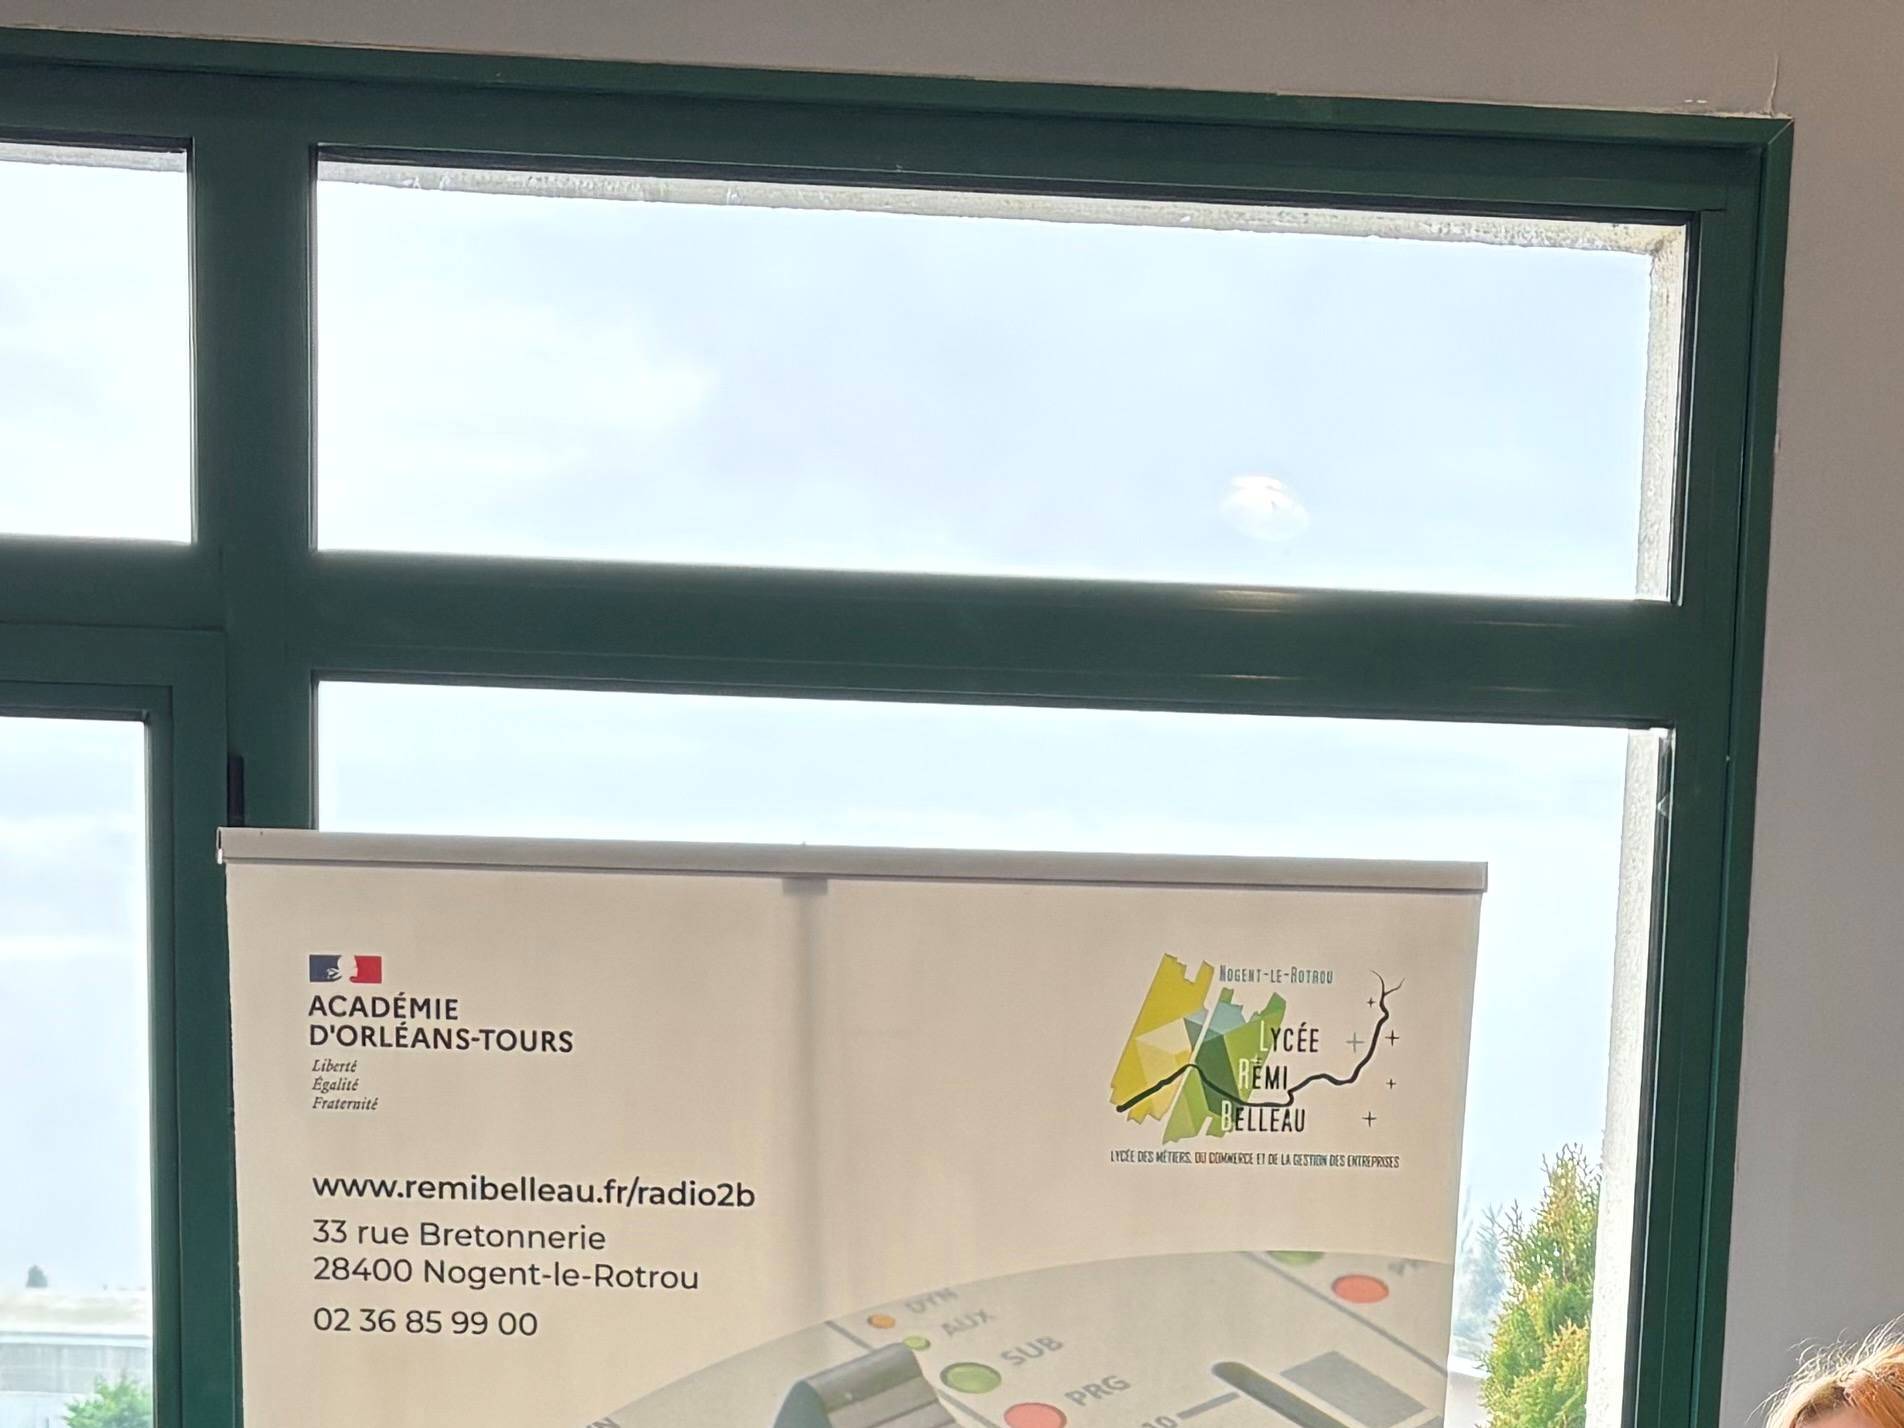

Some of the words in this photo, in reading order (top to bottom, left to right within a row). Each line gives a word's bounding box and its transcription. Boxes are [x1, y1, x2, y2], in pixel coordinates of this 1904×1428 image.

[308, 991, 459, 1021] ACADÉMIE
[310, 1021, 573, 1053] D'ORLÉANS-TOURS
[1259, 1020, 1320, 1053] LYCÉE
[311, 1058, 358, 1074] Liberté
[1238, 1057, 1288, 1091] RÉMI
[311, 1074, 360, 1096] Égalité
[312, 1096, 379, 1111] Fraternité
[1221, 1100, 1306, 1133] BELLEAU
[1137, 1150, 1154, 1163] DES
[312, 1174, 755, 1208] www.remibelleau.fr/radio2b
[312, 1219, 348, 1244] 33
[358, 1225, 409, 1245] rue
[420, 1222, 606, 1250] Bretonnerie
[313, 1256, 413, 1283] 28400
[424, 1259, 698, 1291] Nogent-le-Rotrou
[313, 1307, 351, 1332] 02
[359, 1308, 396, 1333] 36
[405, 1309, 442, 1334] 85
[451, 1310, 488, 1335] 99
[498, 1311, 538, 1337] 00
[1000, 1335, 1064, 1366] SUB
[1064, 1375, 1131, 1406] PRG
